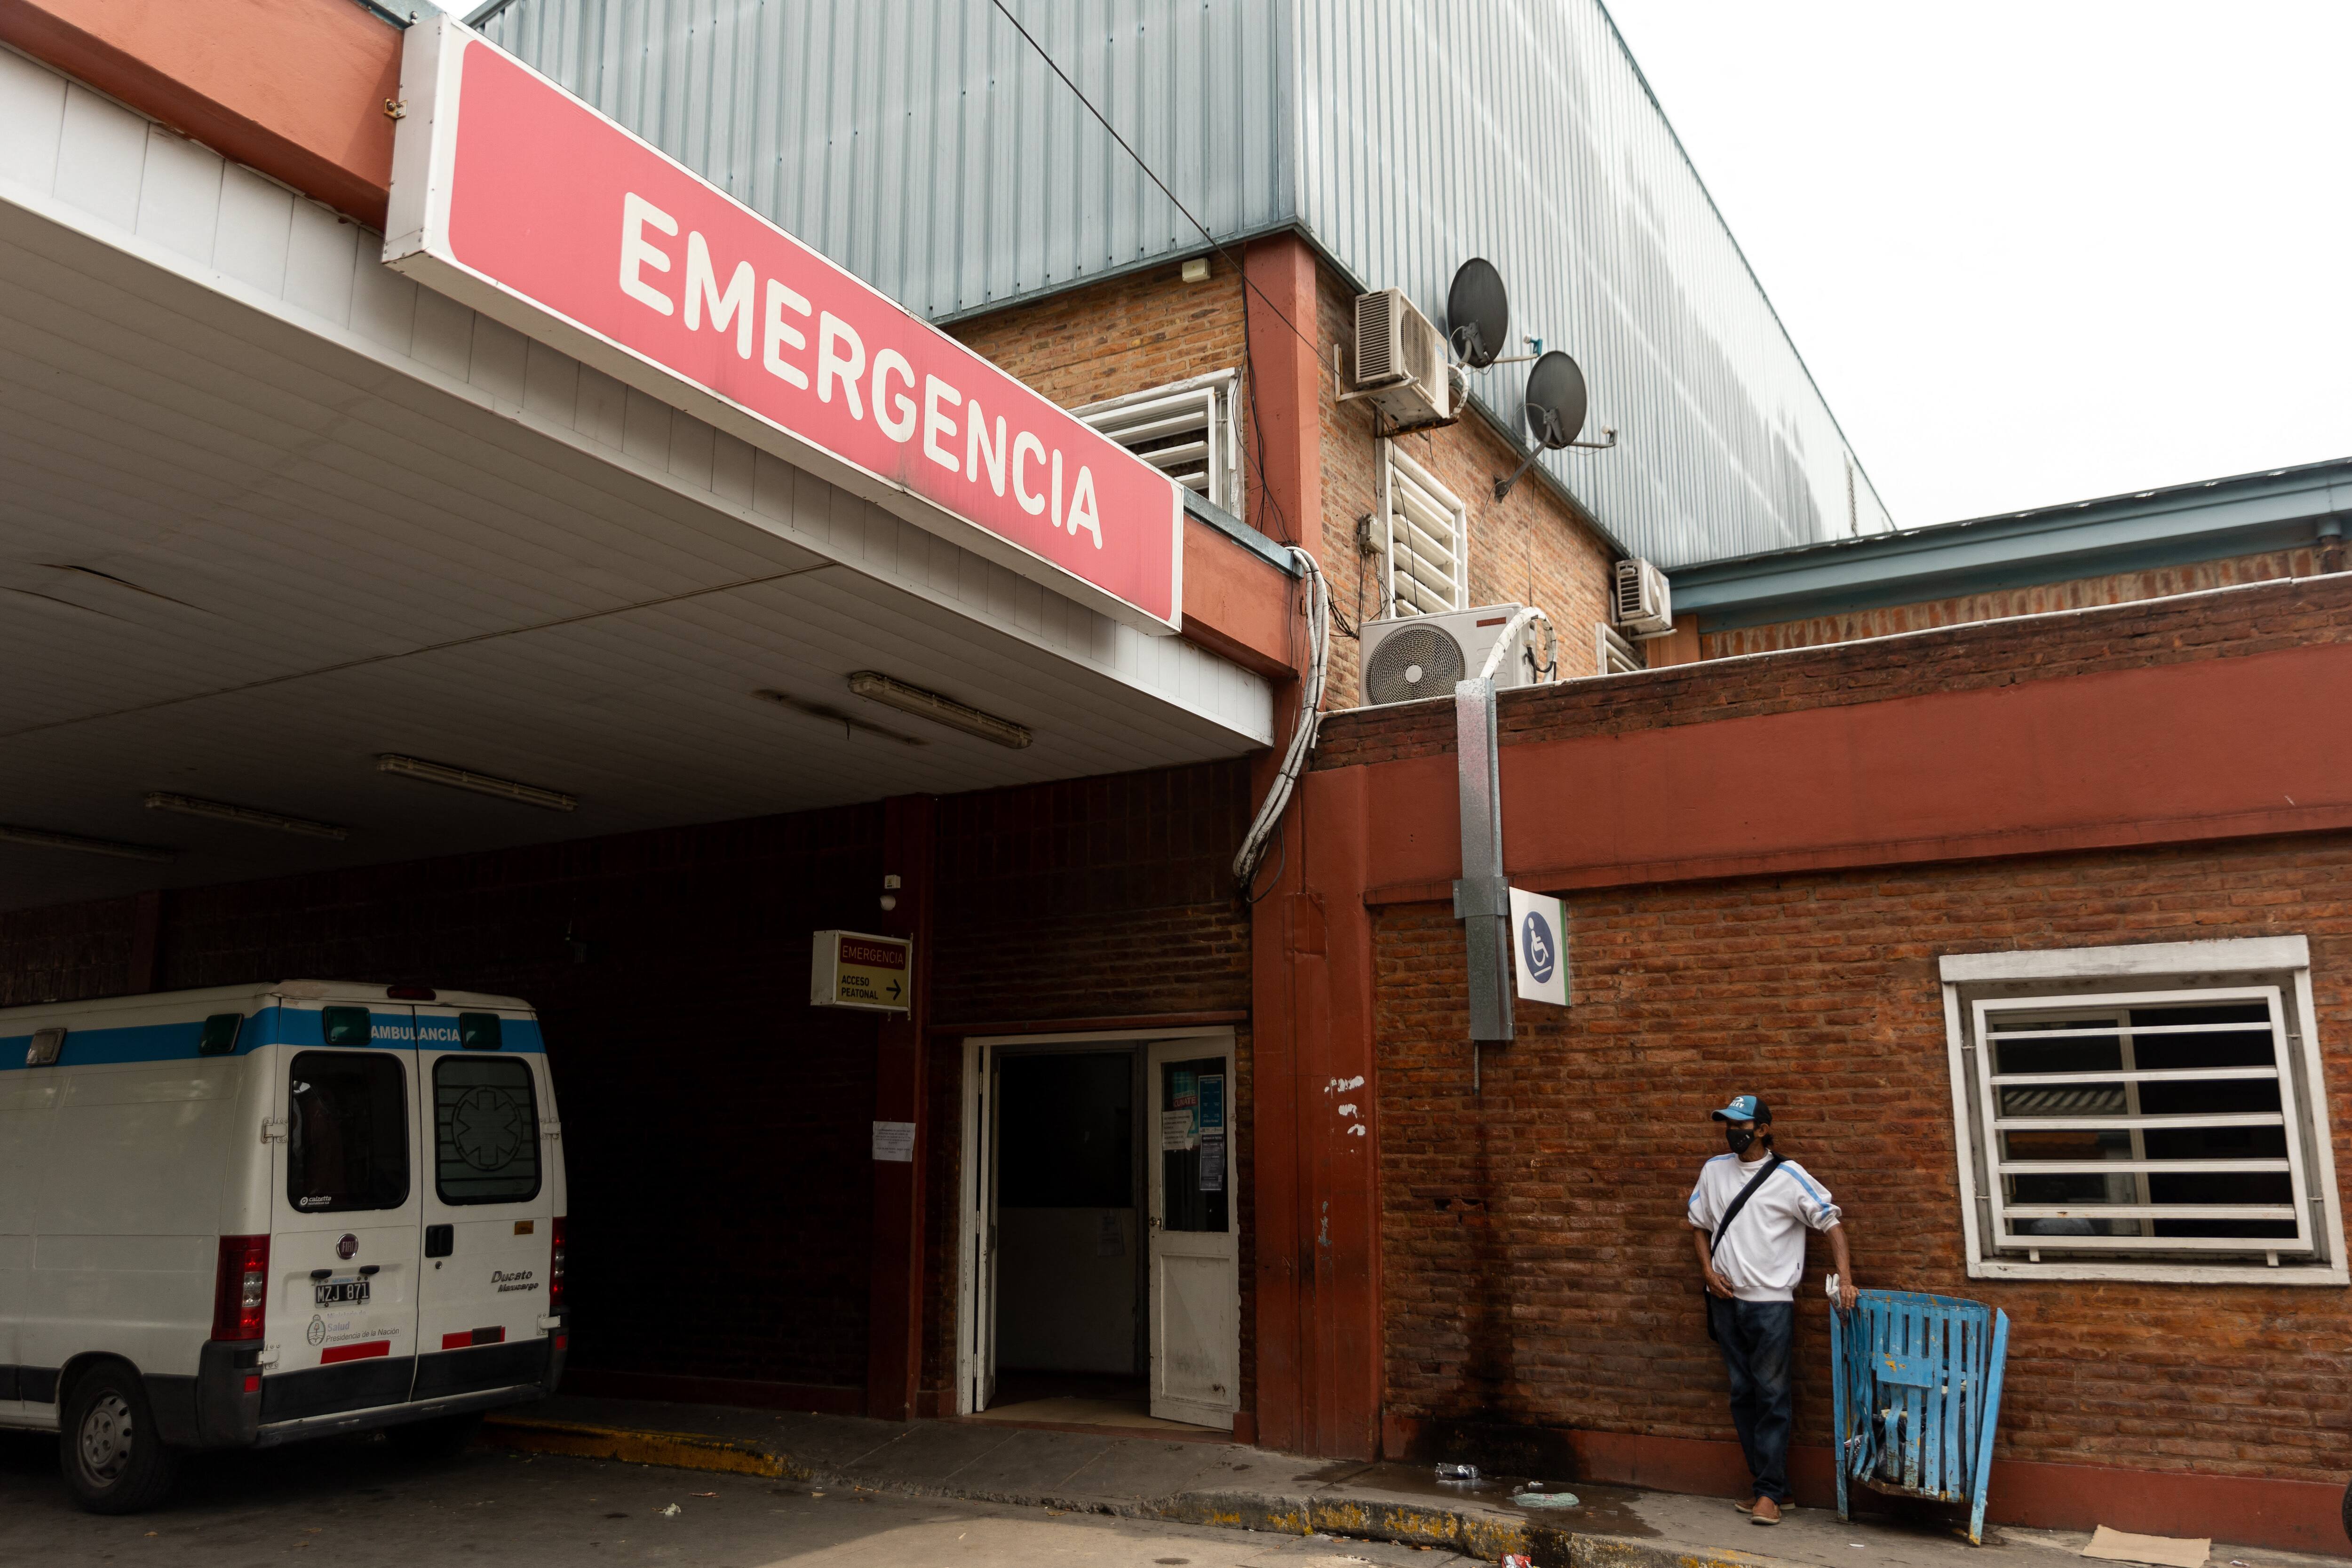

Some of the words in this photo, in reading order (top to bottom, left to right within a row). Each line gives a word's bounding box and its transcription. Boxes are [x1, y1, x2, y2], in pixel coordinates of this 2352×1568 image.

[619, 191, 1103, 550] EMERGENCIA
[842, 945, 904, 965] EMERGENCIA
[842, 974, 870, 987] ACCESO
[841, 987, 879, 1000] PEATONAL
[371, 1025, 461, 1042] AMBULANCIA
[342, 1241, 355, 1252] FIAT
[491, 1270, 532, 1283] Ducato
[318, 1285, 339, 1302] MZJ
[347, 1283, 368, 1300] 871
[327, 1321, 350, 1332] Salud
[326, 1332, 361, 1343] Presidencia
[378, 1327, 399, 1336] Nación
